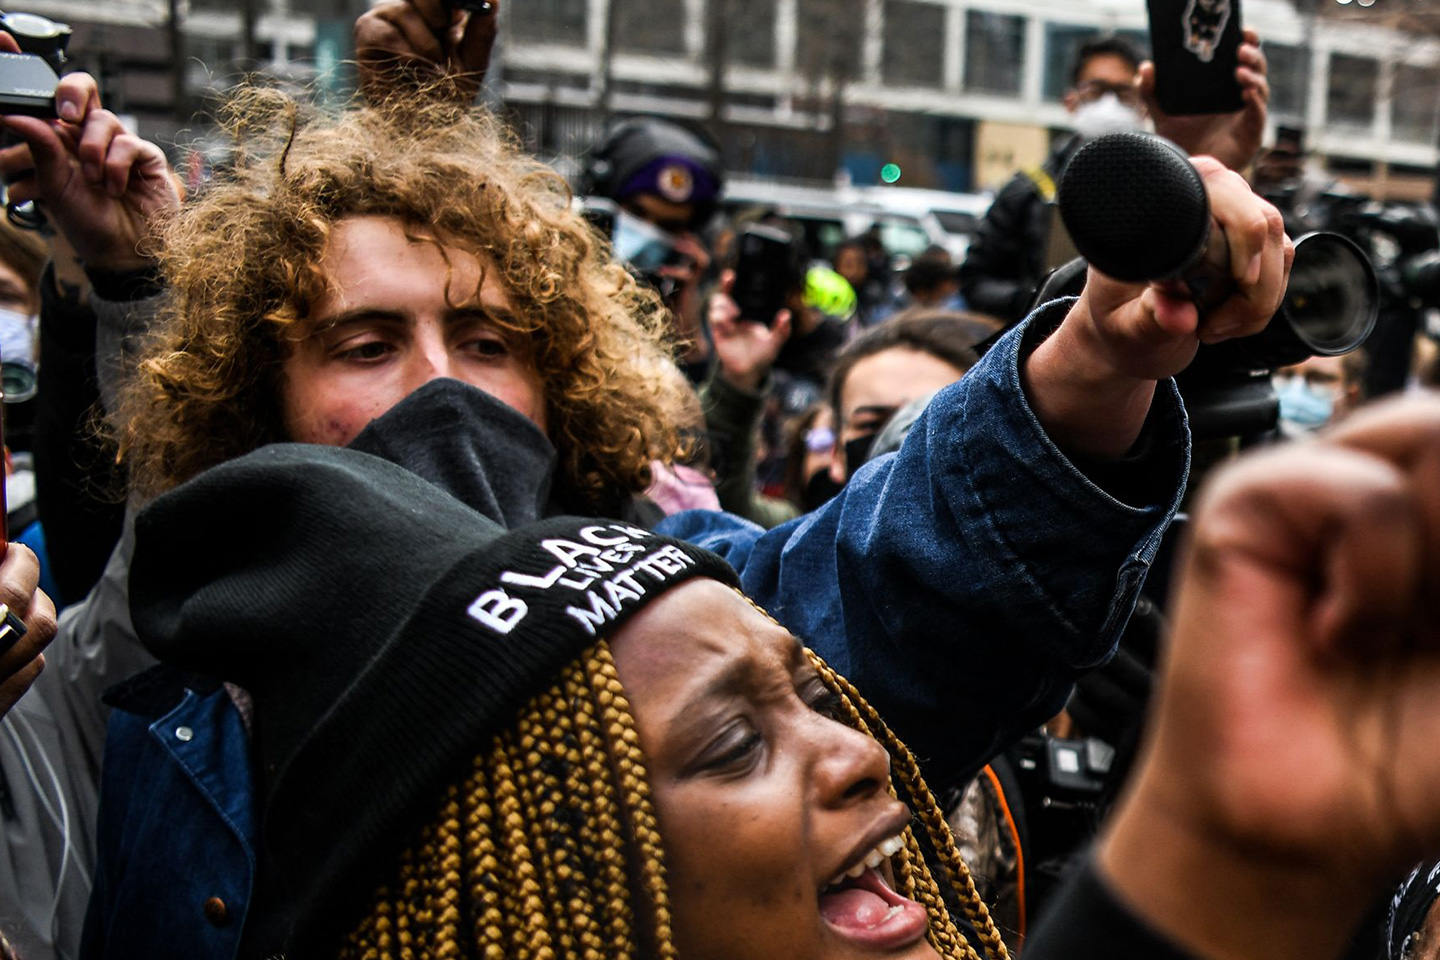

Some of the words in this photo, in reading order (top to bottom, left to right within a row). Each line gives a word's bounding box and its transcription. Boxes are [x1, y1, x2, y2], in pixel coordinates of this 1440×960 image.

[467, 524, 651, 634] BLACK
[558, 542, 646, 590] LIVES
[566, 544, 696, 635] MATTER
